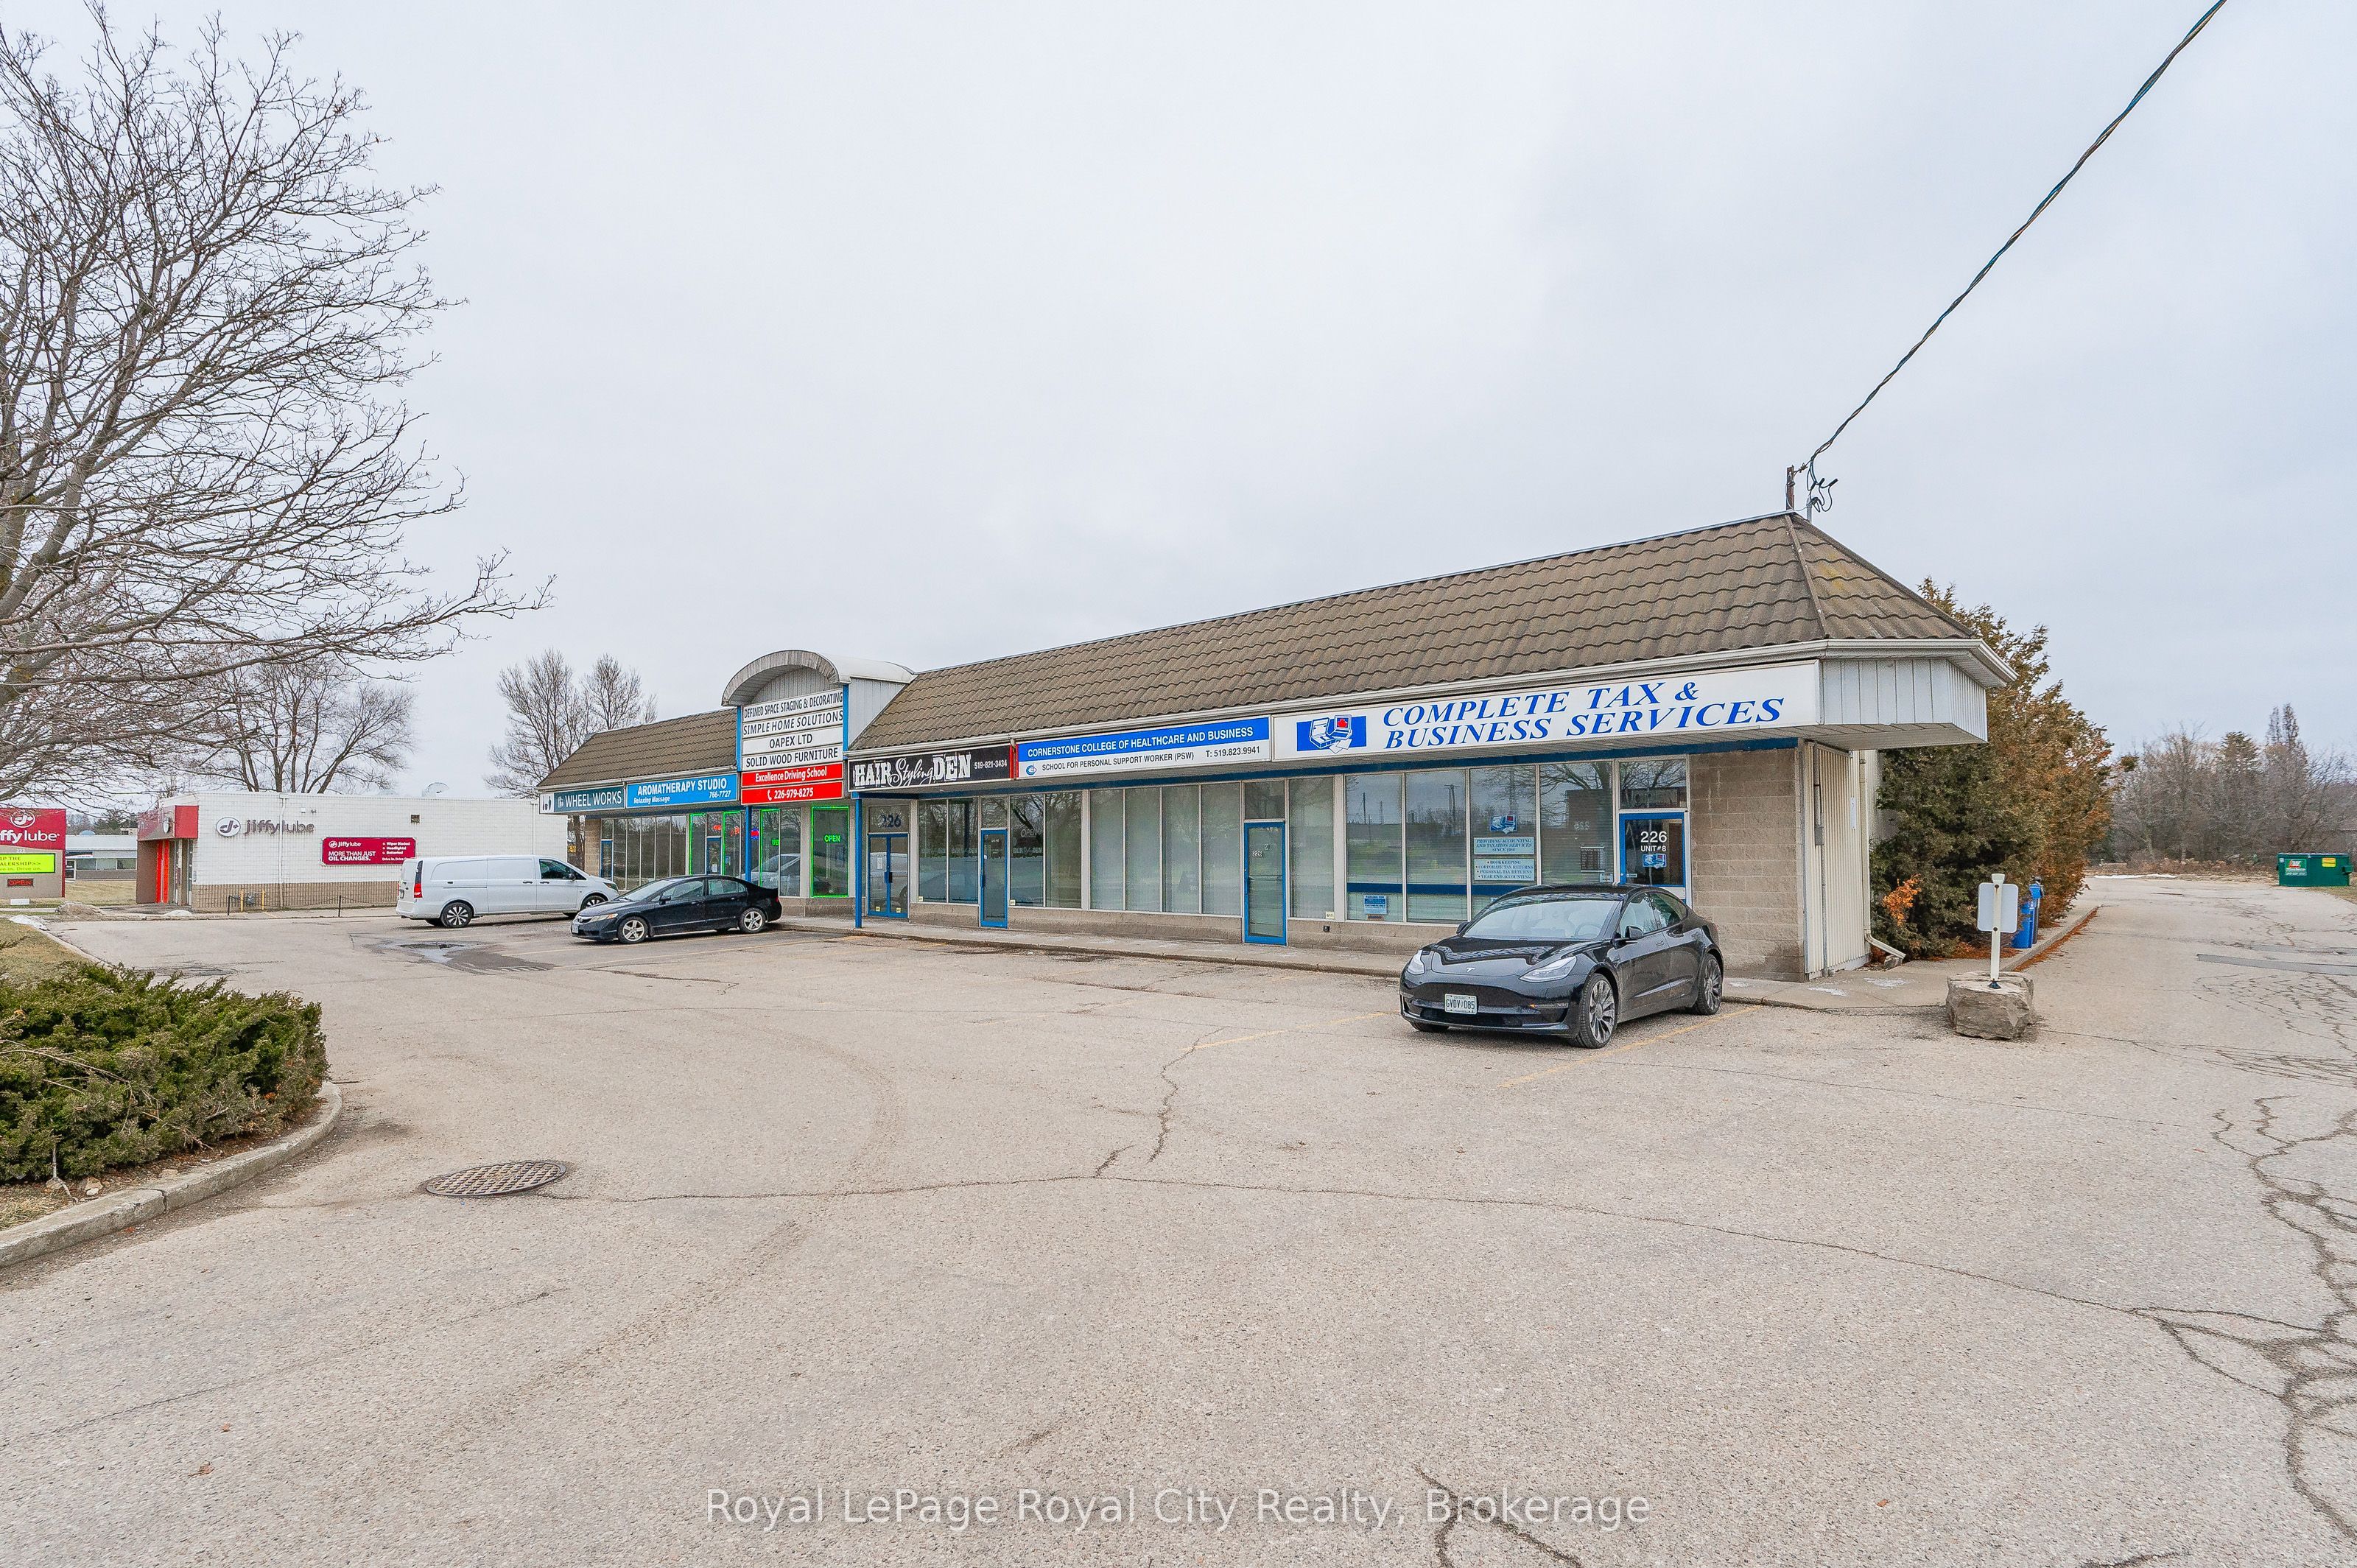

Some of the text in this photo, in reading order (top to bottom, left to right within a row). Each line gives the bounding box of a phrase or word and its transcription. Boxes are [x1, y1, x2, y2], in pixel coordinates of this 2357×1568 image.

[744, 692, 843, 718] DEFINED SPACE STAGING & DECORATING
[1383, 682, 1699, 726] COMPLETE TAX &
[743, 710, 843, 735] SIMPLE HOME SOLUTIONS
[1384, 697, 1785, 749] BUSINESS SERVICES
[769, 734, 813, 748] OAPEX LTD
[1028, 726, 1254, 757] CORNERSTONE COLLEGE OF HEALTHCARE AND BUSINESS
[745, 748, 838, 767] SOLID WOOD FURNITURE
[1041, 762, 1066, 771] SCHOOL
[1080, 759, 1112, 767] PERSONAL
[1113, 756, 1142, 764] SUPPORT
[1143, 753, 1173, 762] WORKER
[1174, 752, 1194, 762] (PSW)
[1214, 746, 1260, 757] 519.823.9941
[755, 766, 827, 782] Excellence Driving School
[854, 752, 1008, 787] HAIR Styling DEN 519-821-3434
[637, 778, 727, 796] AROMATHERAPY STUDIO
[709, 790, 731, 798] 766-7727
[774, 787, 814, 799] 226-979-8275
[565, 794, 591, 808] WHEEL
[592, 791, 622, 806] WORKS
[24, 830, 57, 841] lube
[245, 820, 315, 835] jiffy lube
[824, 834, 840, 843] OPEN
[1640, 831, 1668, 843] 226
